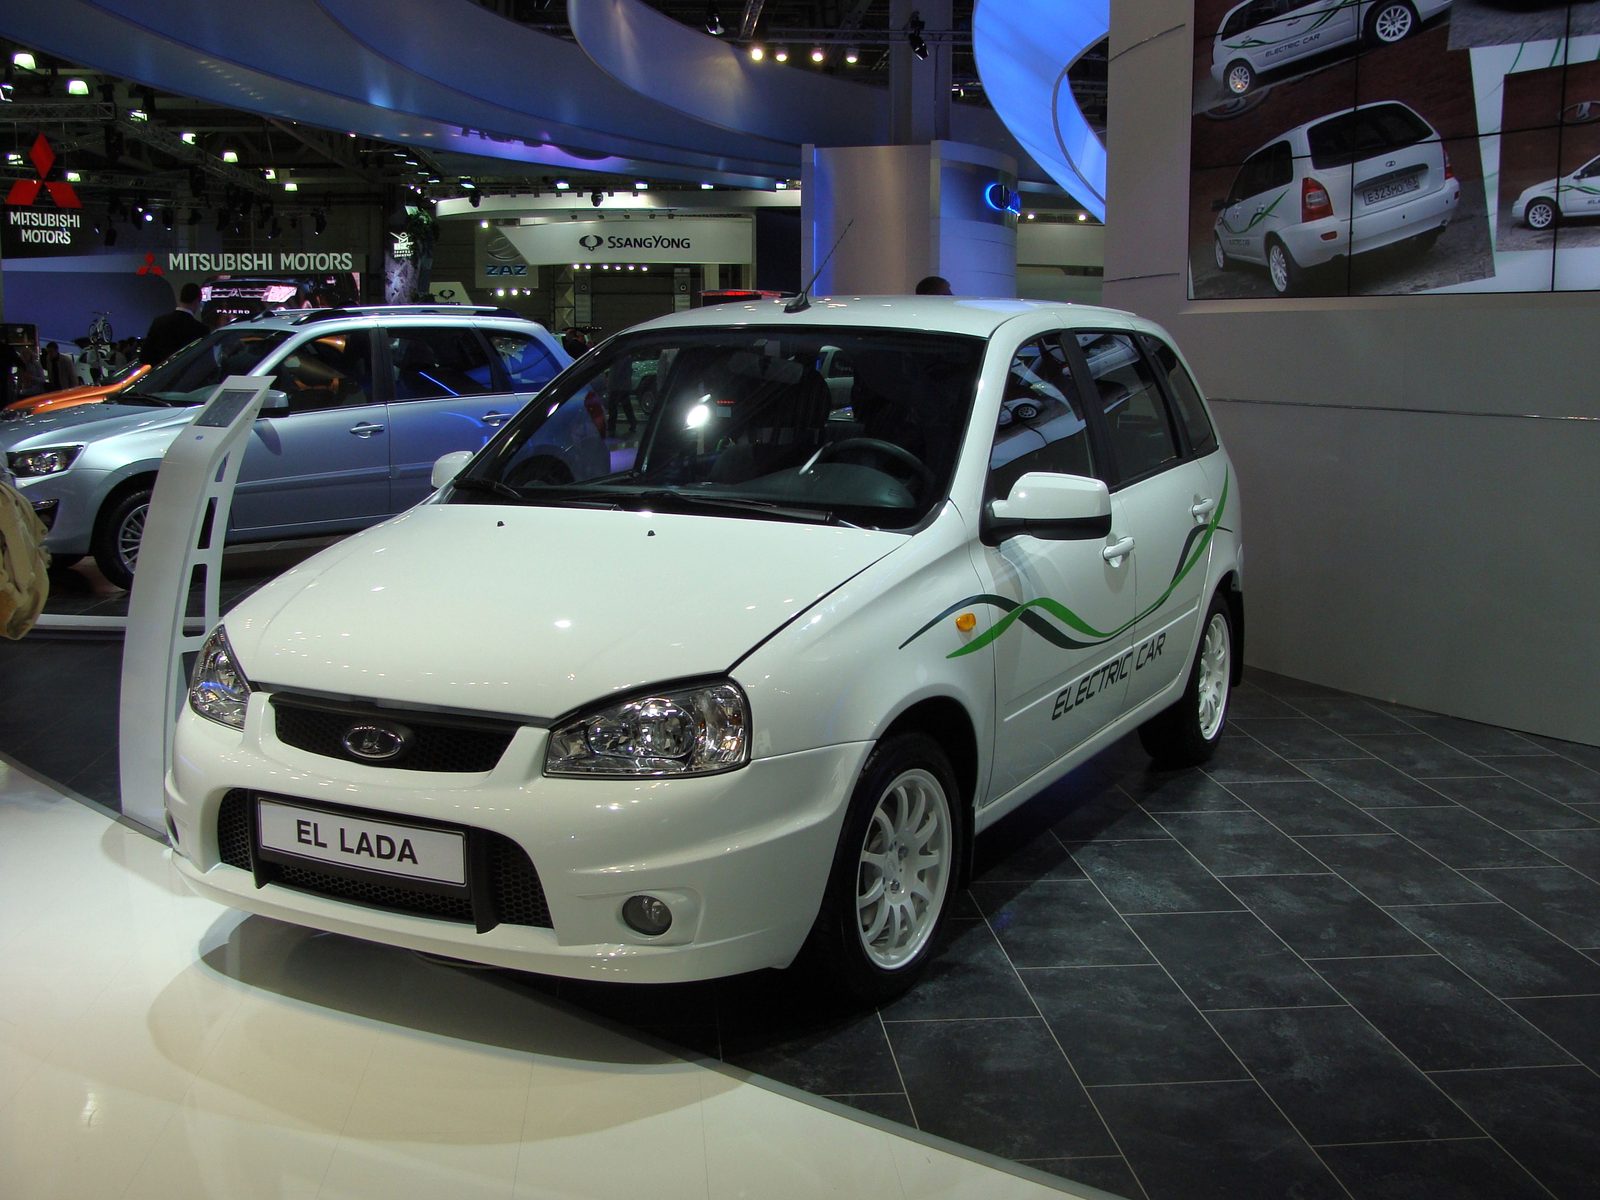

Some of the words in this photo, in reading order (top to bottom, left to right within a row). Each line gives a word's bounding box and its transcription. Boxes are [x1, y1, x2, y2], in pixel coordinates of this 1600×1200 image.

[1302, 33, 1321, 44] CAR
[10, 211, 80, 228] MITSUBISHI
[21, 230, 71, 245] MOTORS
[168, 252, 273, 272] MITSUBISHI
[279, 252, 353, 272] MOTORS
[485, 264, 528, 276] ZAZ
[1051, 651, 1134, 720] ELECTRIC
[1135, 632, 1167, 671] CAR
[296, 819, 328, 849] EL
[339, 828, 419, 865] LADA
